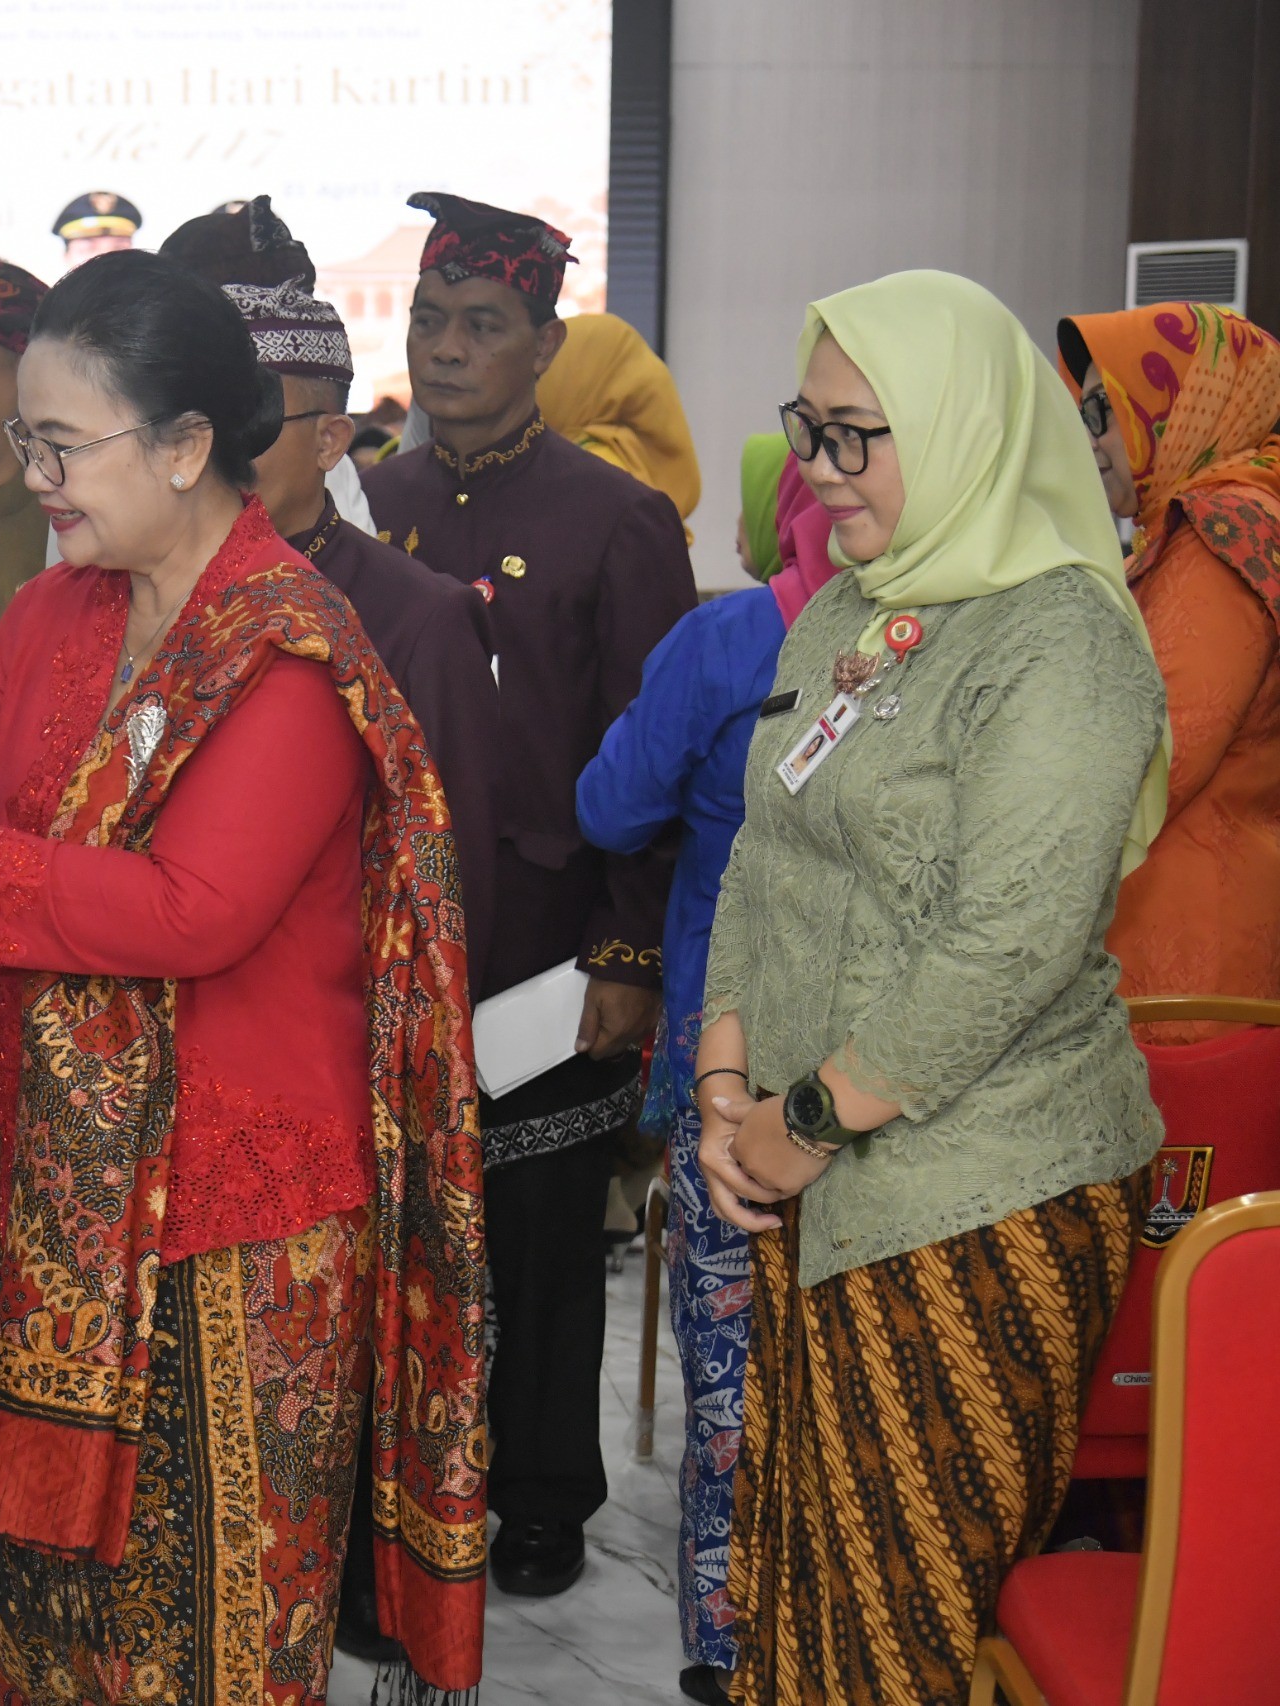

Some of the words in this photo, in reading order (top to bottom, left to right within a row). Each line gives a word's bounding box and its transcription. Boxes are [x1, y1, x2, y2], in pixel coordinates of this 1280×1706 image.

[179, 63, 304, 107] Hari
[331, 63, 534, 106] Kartini
[61, 121, 161, 163] Ke
